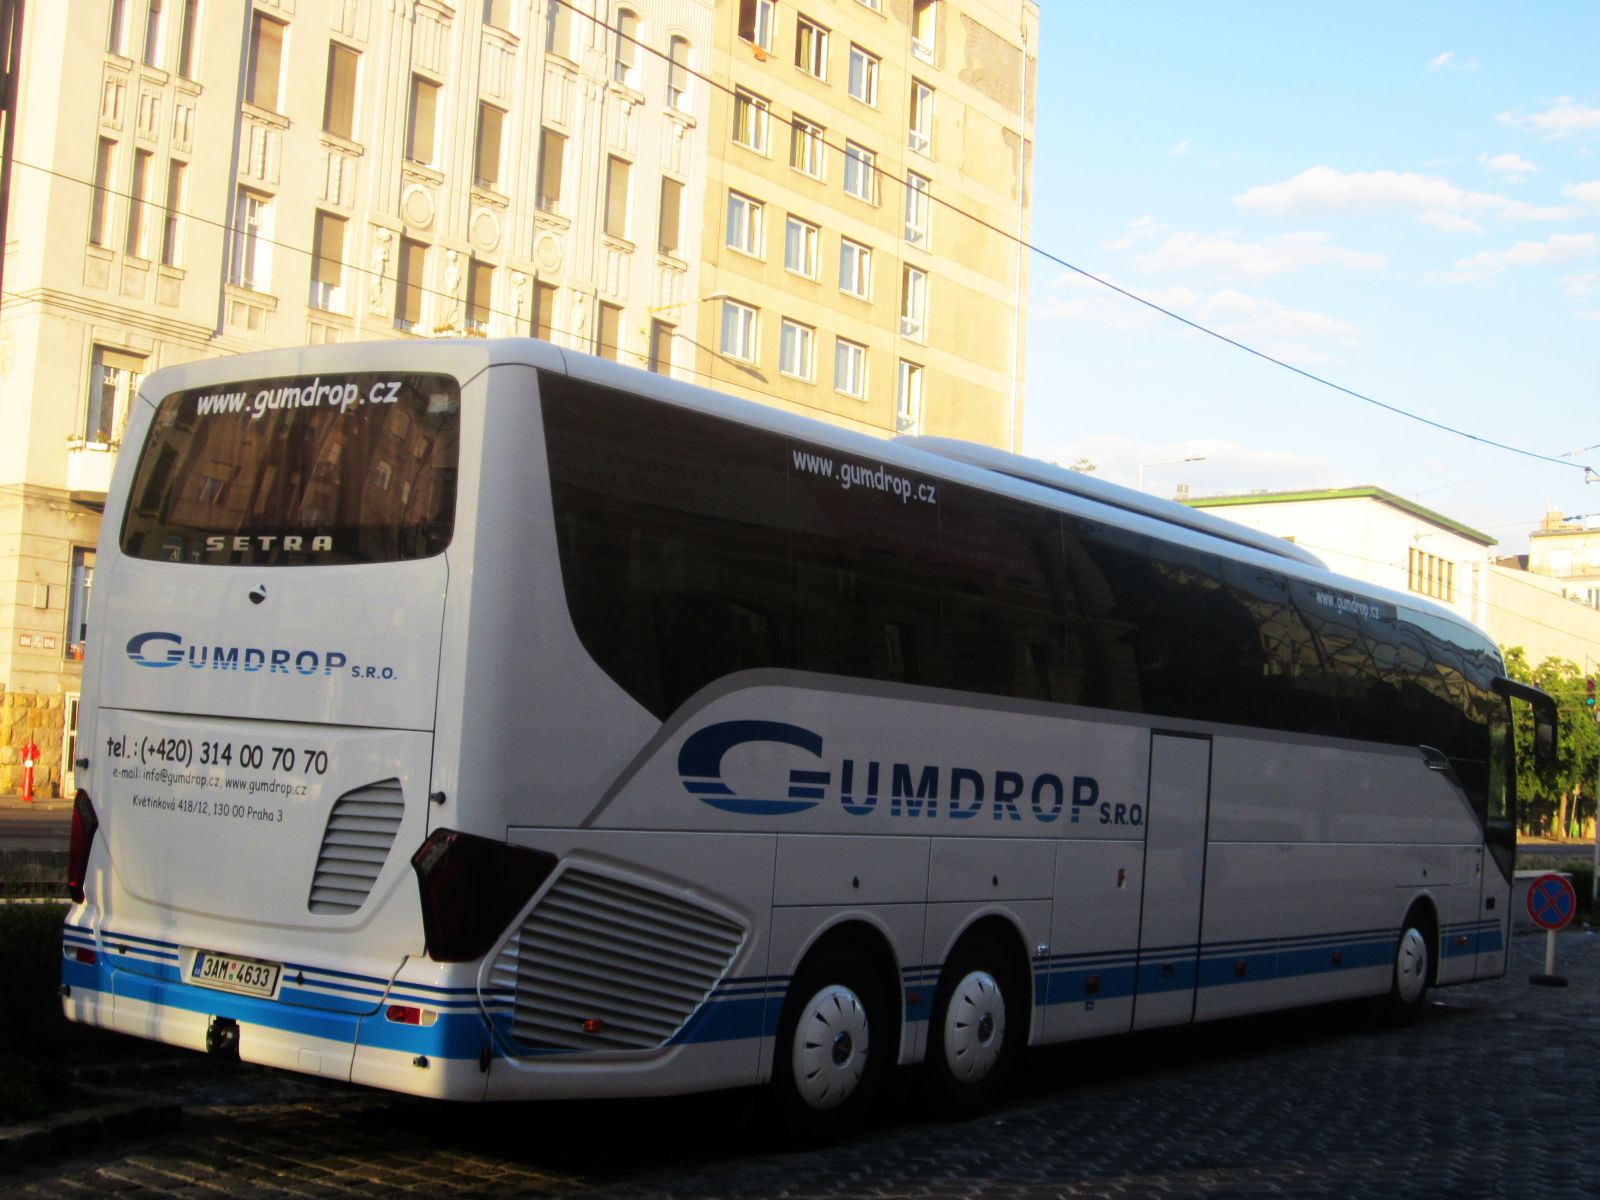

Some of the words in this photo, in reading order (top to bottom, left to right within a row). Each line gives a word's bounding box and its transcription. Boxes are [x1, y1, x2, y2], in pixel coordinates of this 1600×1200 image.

[196, 377, 402, 419] www.gumdrop.cz
[793, 450, 936, 504] www.gumdrop.cz
[206, 535, 333, 552] SETRA
[1315, 591, 1379, 621] www.gumdrop.cz
[125, 631, 347, 675] GUMDROP
[351, 666, 398, 680] S.R.O.
[200, 741, 232, 766] 314
[239, 744, 263, 769] 00
[271, 747, 295, 772] 70
[303, 750, 328, 775] 70
[677, 719, 1100, 823] GUMDROP
[1099, 802, 1144, 826] S.R.O.
[112, 767, 141, 779] e-mail:
[225, 777, 307, 798] www.gumdrop.cz
[213, 803, 230, 817] 130
[232, 806, 245, 819] 00
[247, 807, 274, 822] Praha
[277, 810, 283, 822] 3
[204, 958, 229, 979] 3AM
[235, 964, 270, 987] 4633
